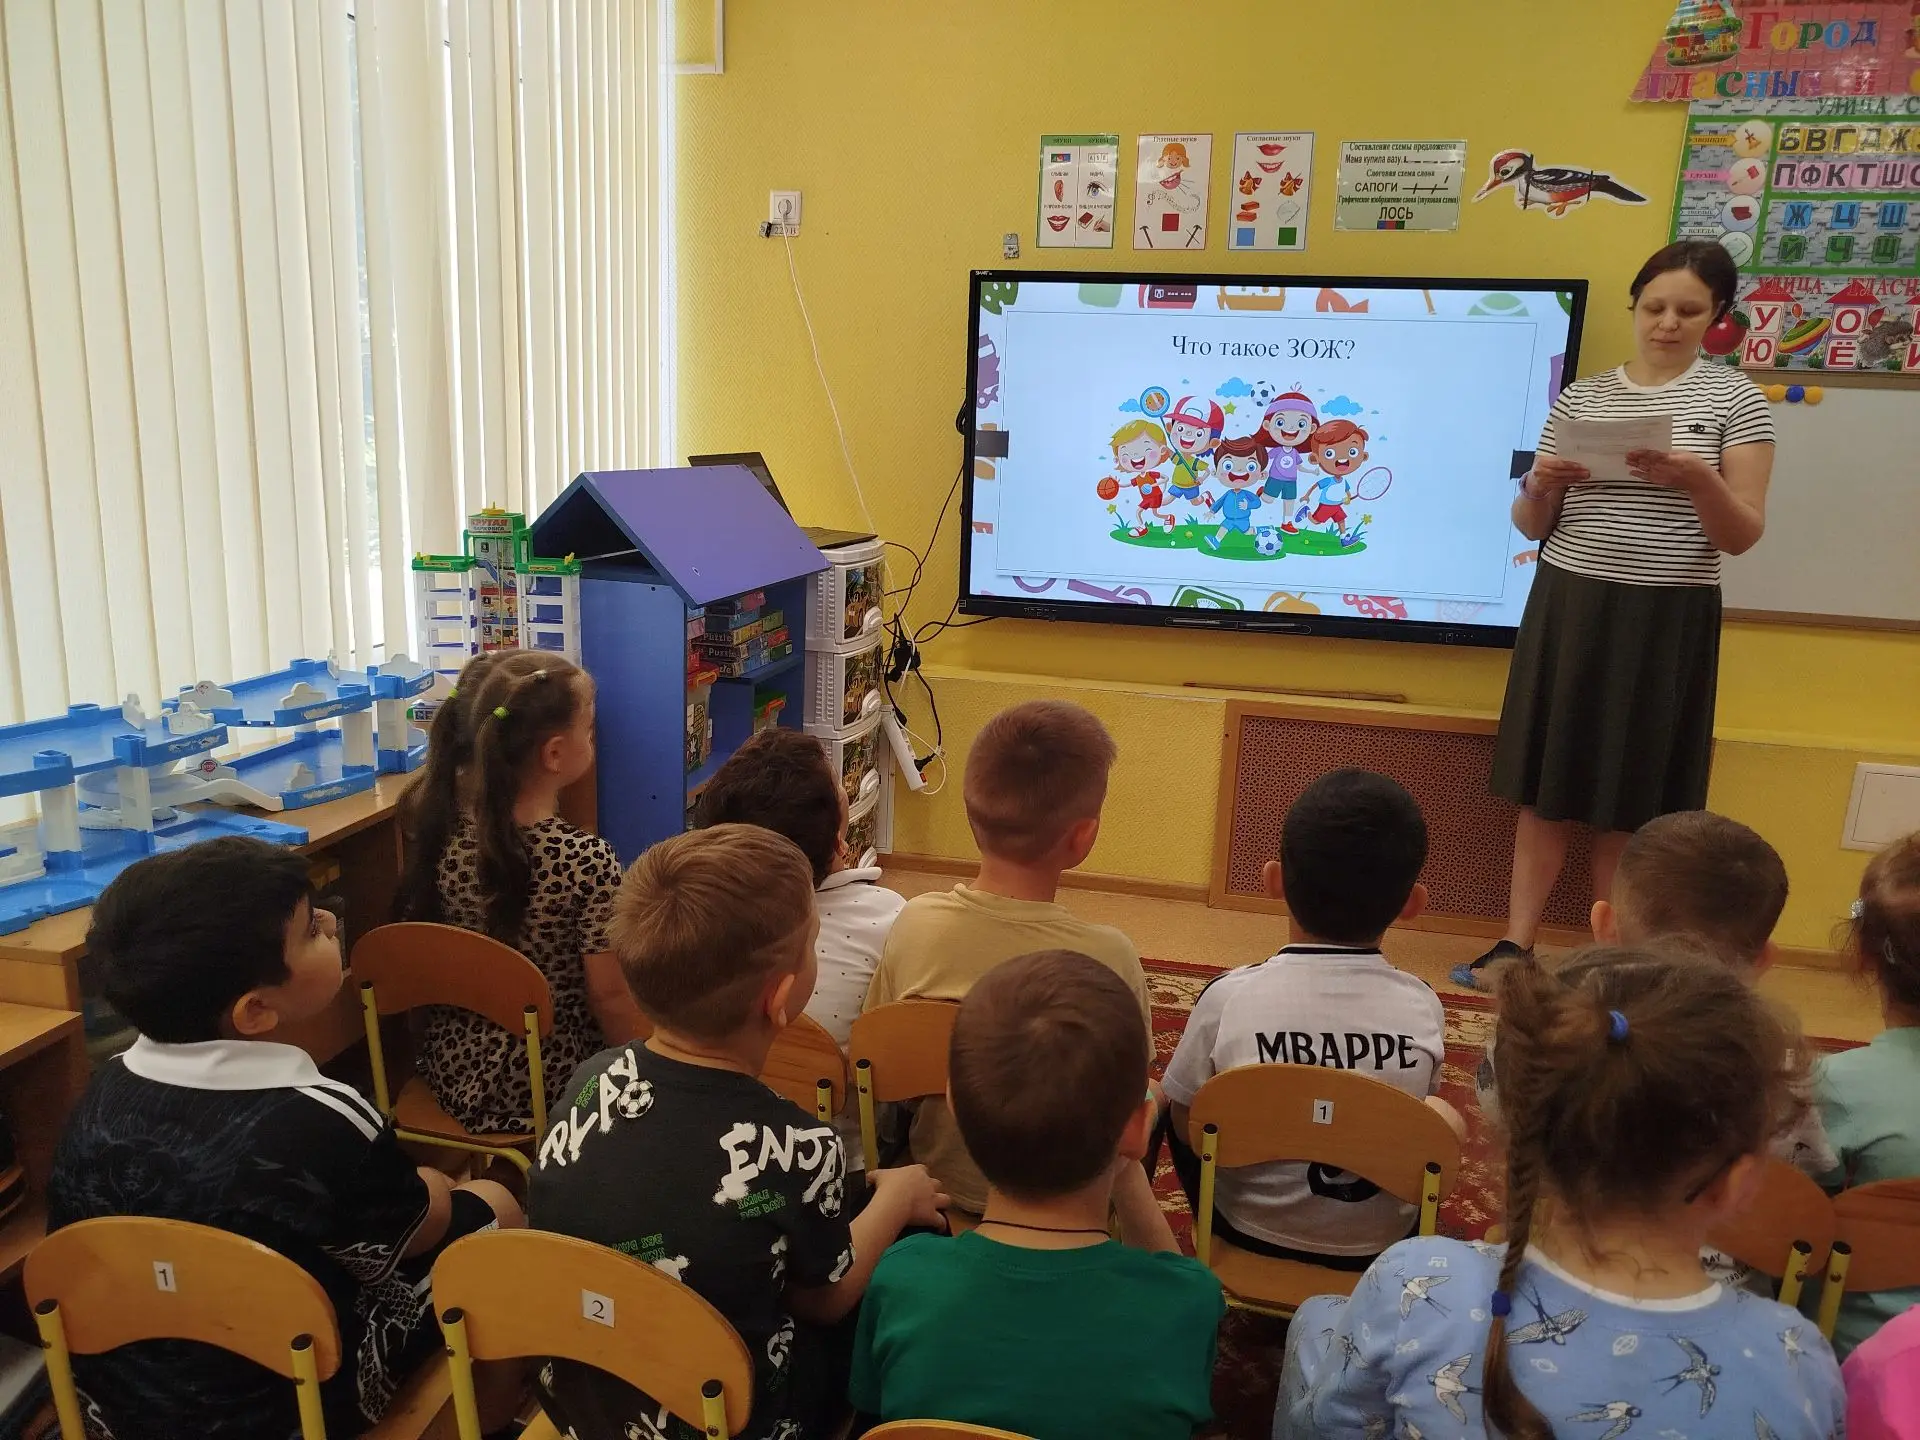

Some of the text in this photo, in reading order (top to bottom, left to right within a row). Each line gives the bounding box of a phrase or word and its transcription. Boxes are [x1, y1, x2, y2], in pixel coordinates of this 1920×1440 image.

[1354, 182, 1398, 193] САПОГИ
[1378, 206, 1414, 220] ЛОСЬ
[1754, 306, 1862, 334] У О
[1172, 335, 1356, 360] Что такое ЗОЖ?
[1745, 338, 1772, 362] Ю
[1828, 341, 1856, 366] Ё
[1255, 1031, 1418, 1070] MBAPPE
[1319, 1104, 1328, 1120] 1
[158, 1268, 169, 1287] 1
[592, 1300, 605, 1320] 2
